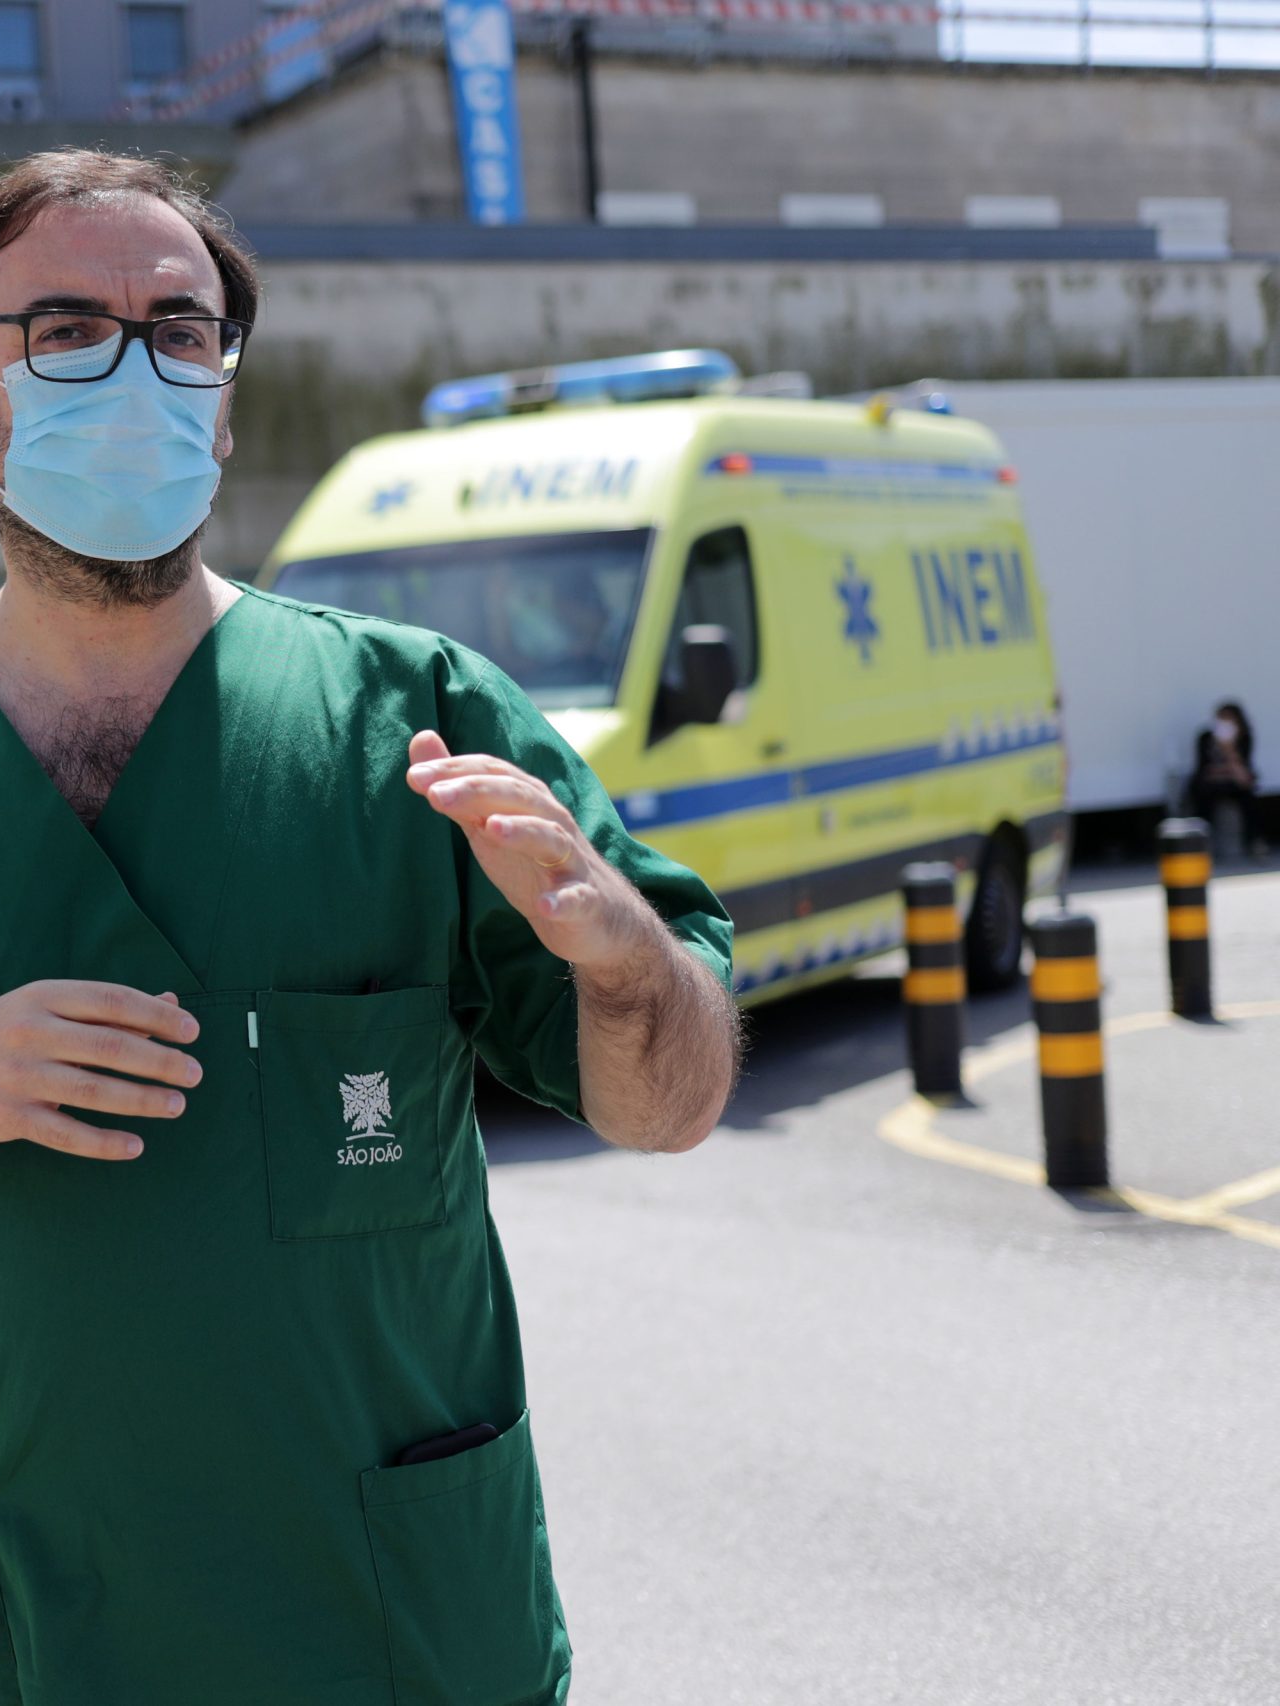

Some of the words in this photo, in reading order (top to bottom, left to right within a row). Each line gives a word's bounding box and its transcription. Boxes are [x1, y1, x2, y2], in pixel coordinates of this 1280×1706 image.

[474, 456, 639, 505] INEM
[909, 547, 1037, 653] INEM
[337, 1144, 368, 1166] SÃO
[369, 1142, 403, 1166] JOÃO
